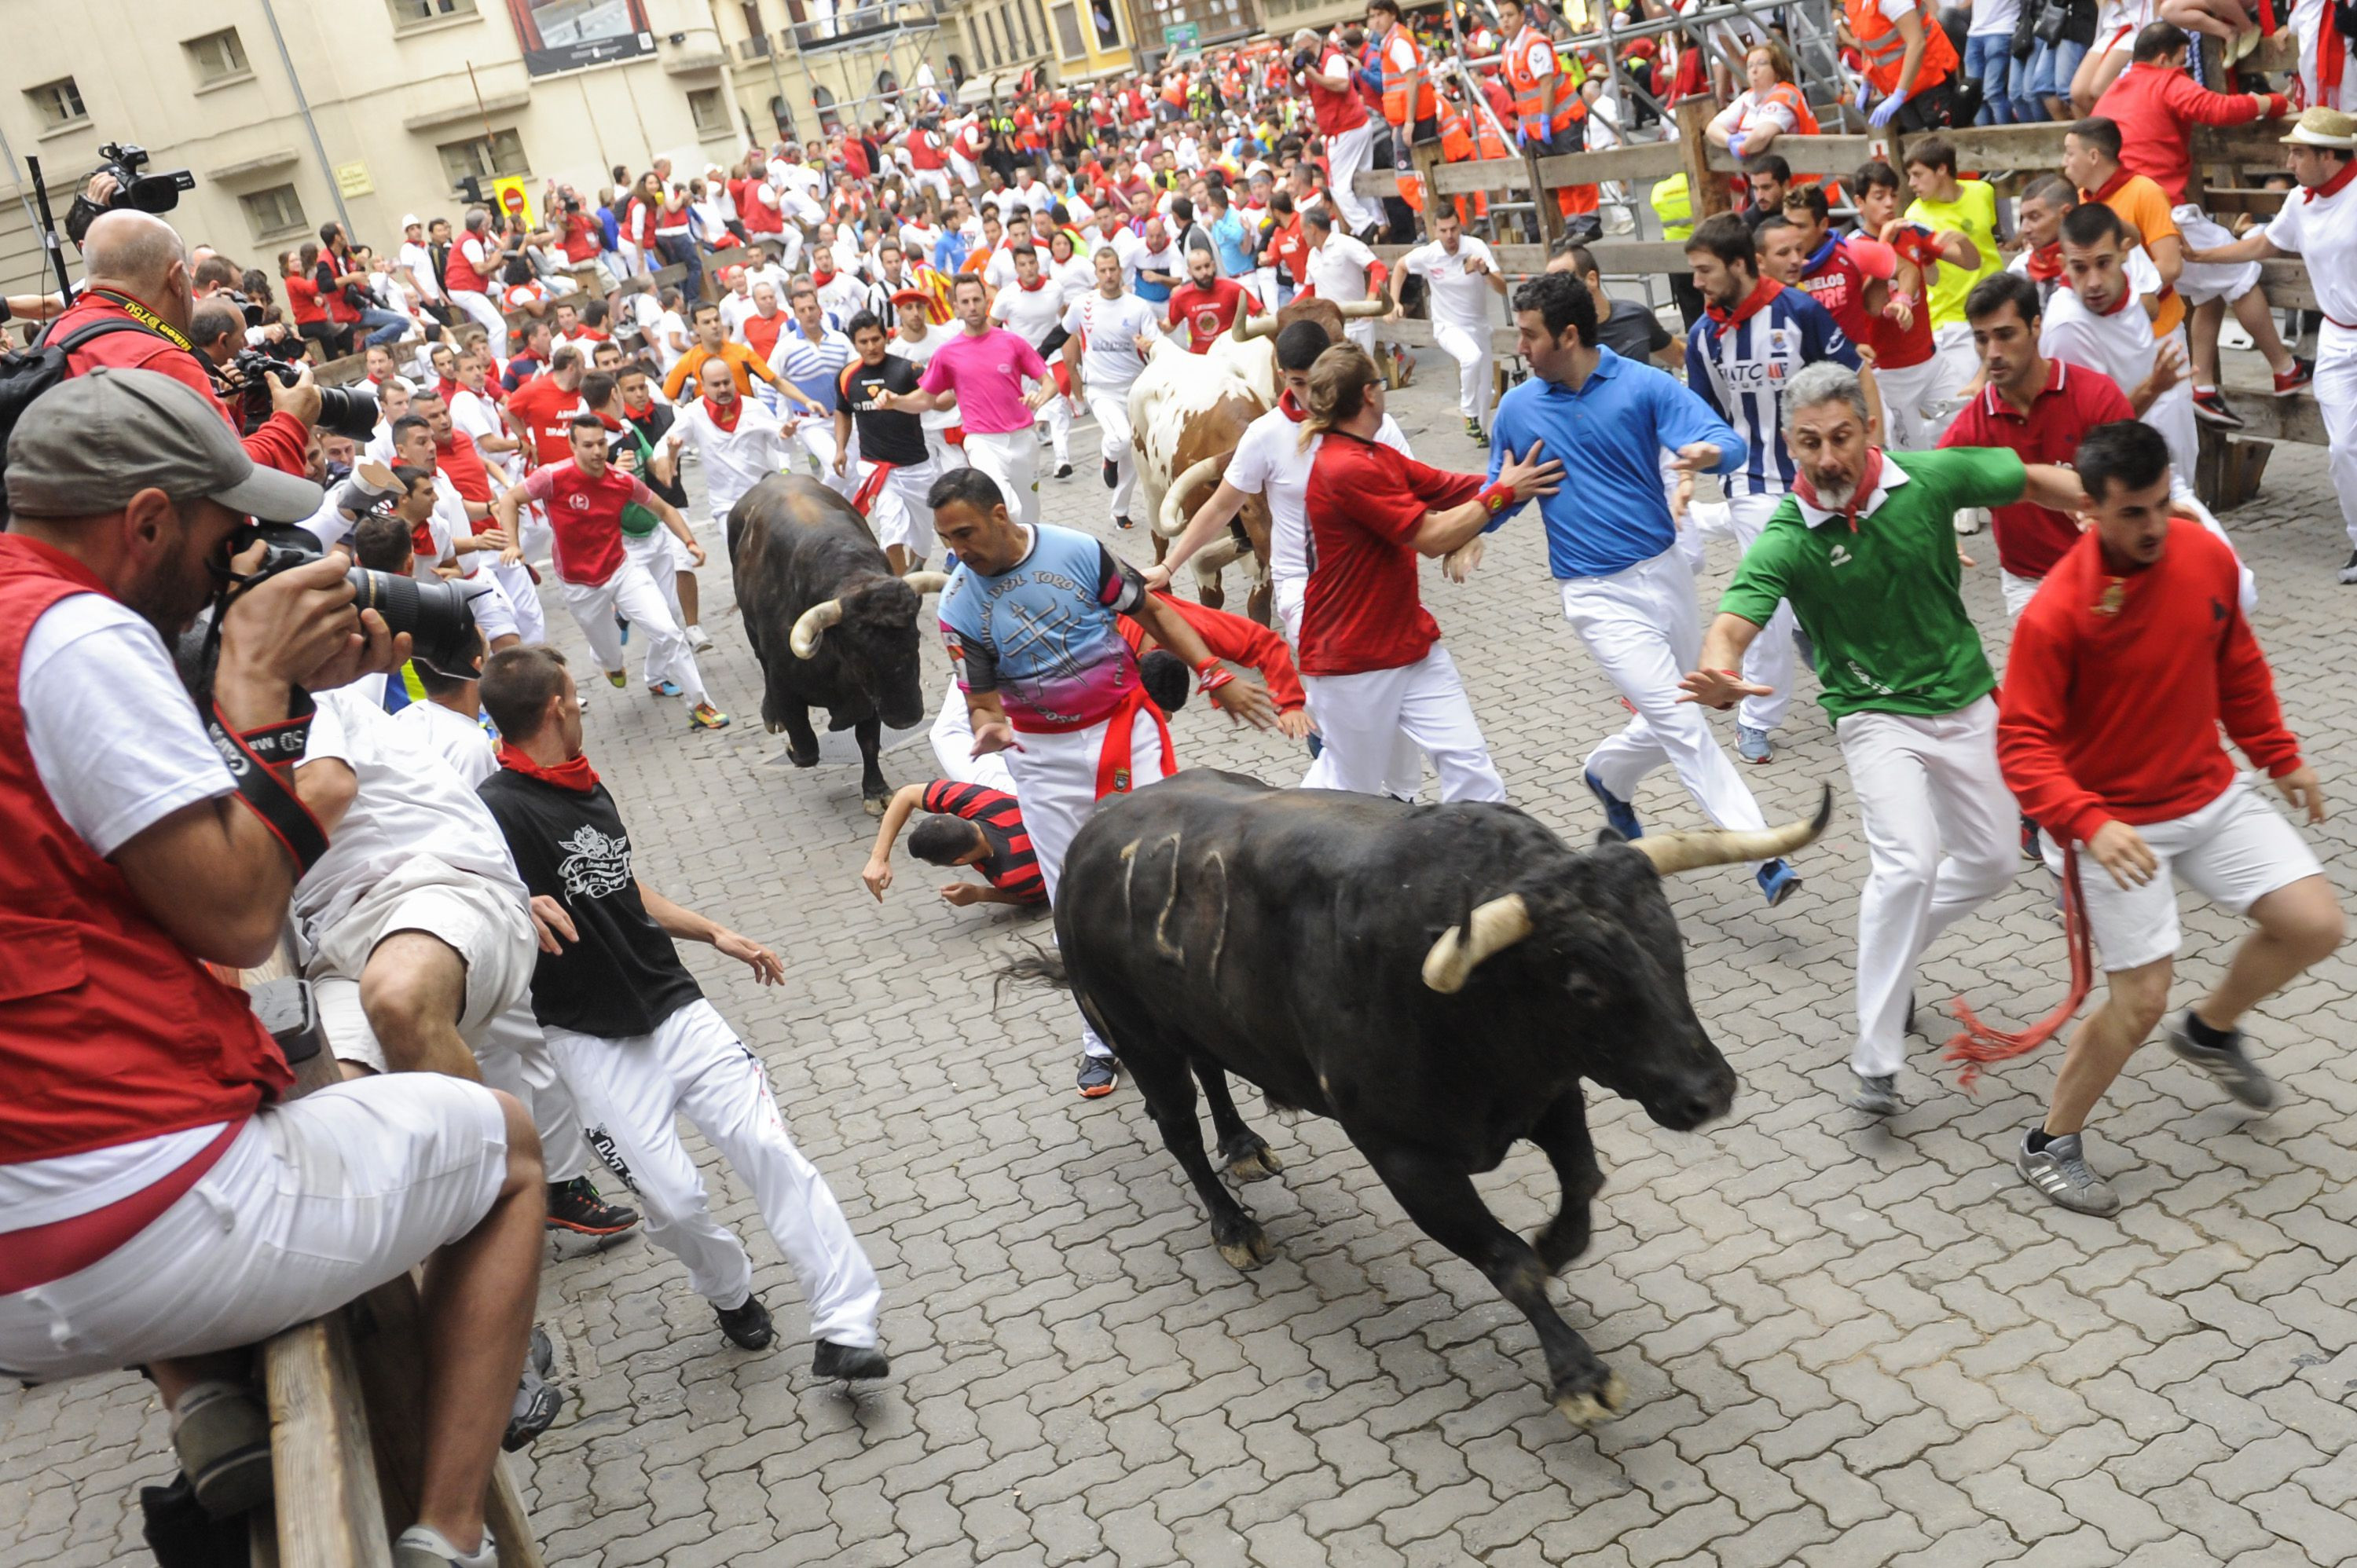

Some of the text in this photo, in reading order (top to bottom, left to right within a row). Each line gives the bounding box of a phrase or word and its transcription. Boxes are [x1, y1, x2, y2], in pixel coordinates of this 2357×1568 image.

[159, 324, 192, 352] Nikon
[987, 573, 1028, 600] DEL
[1032, 570, 1076, 591] TORO
